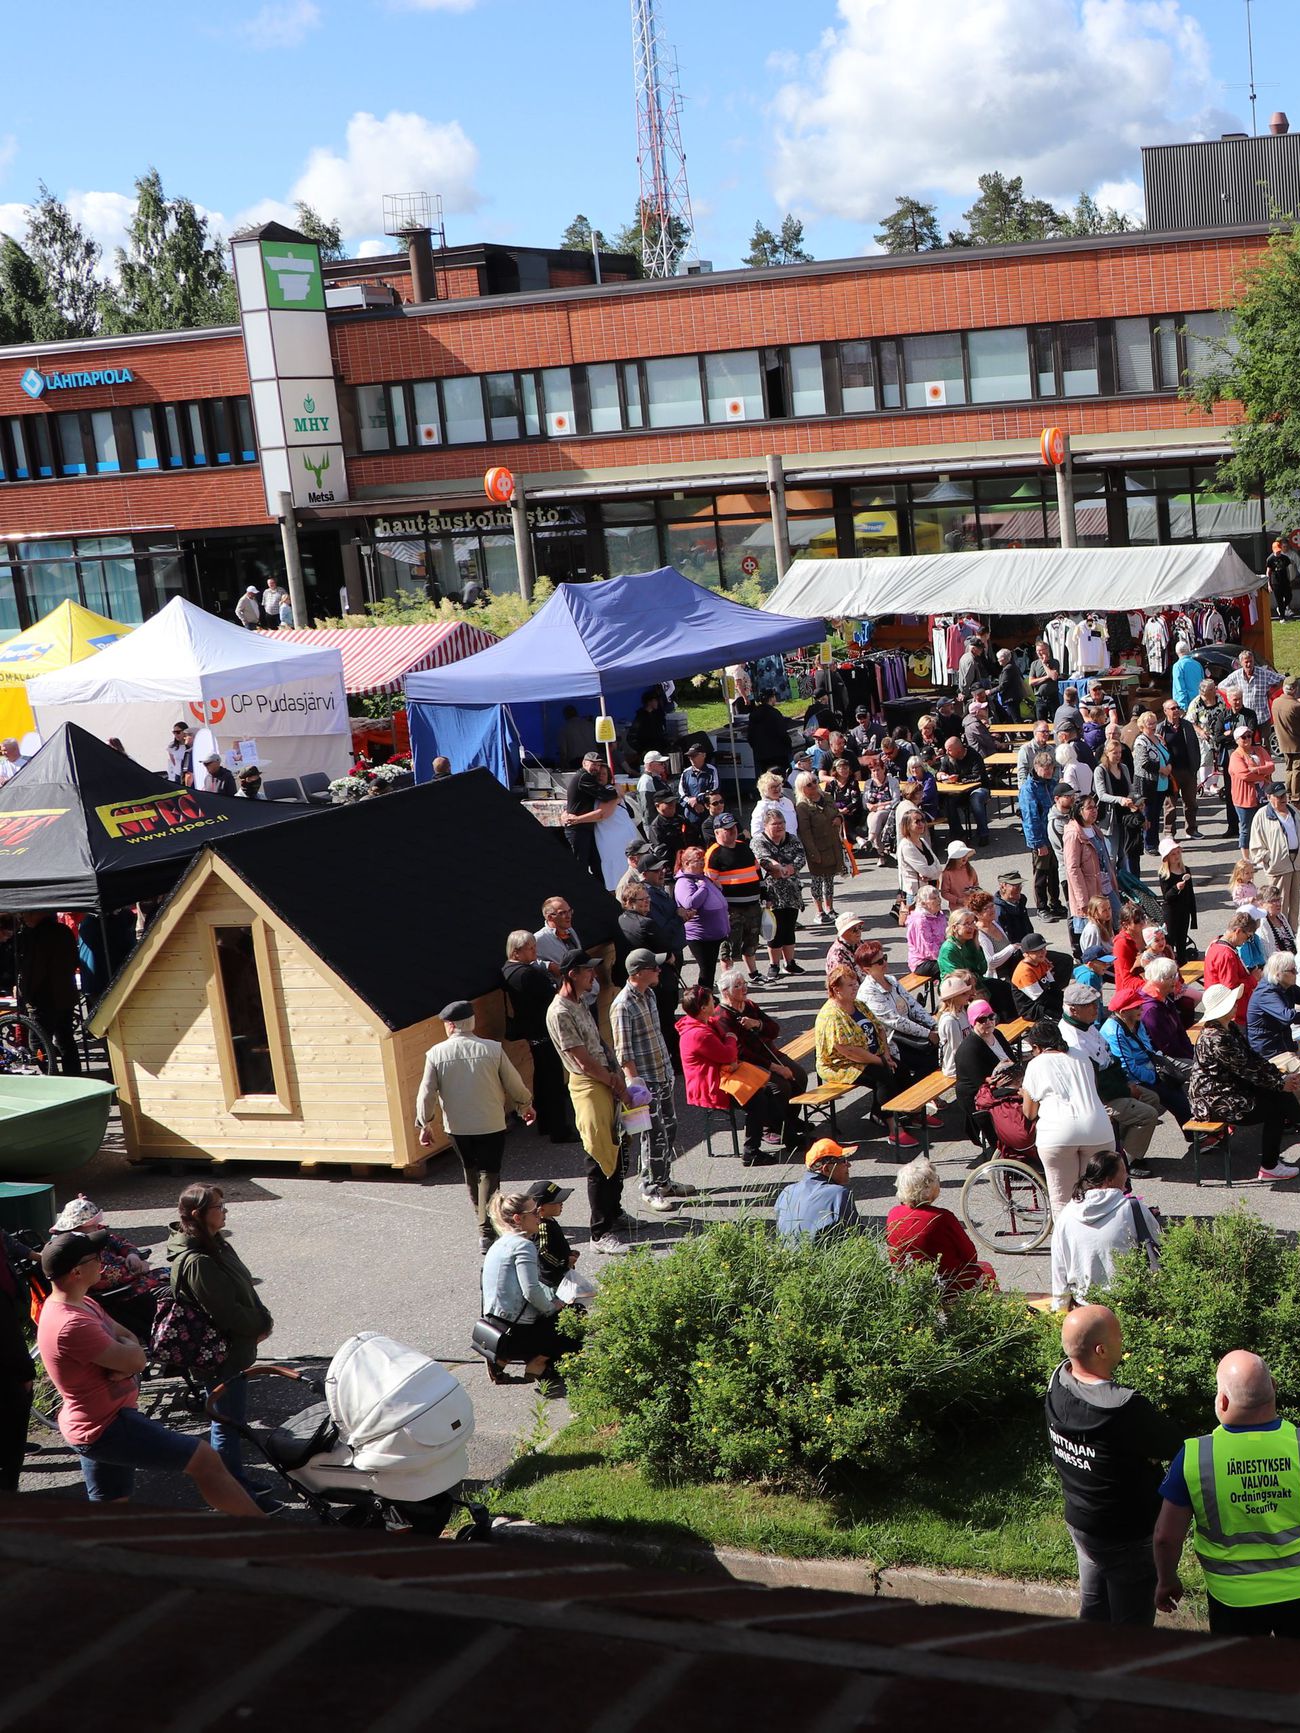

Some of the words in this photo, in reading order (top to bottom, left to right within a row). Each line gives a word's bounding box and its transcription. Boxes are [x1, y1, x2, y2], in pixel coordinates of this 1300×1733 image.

[46, 368, 132, 389] LÄHITAPIOLA
[293, 417, 329, 432] MHY
[308, 491, 334, 503] Metsä
[377, 506, 560, 534] hautaustoimsto
[231, 694, 252, 713] OP
[256, 692, 336, 715] Pudasjärvi
[1227, 1458, 1291, 1475] JÄRJESTYKSEN
[1241, 1474, 1279, 1489] VALVOJA
[1230, 1488, 1292, 1503] Ordningsvakt
[1245, 1501, 1278, 1514] Security
